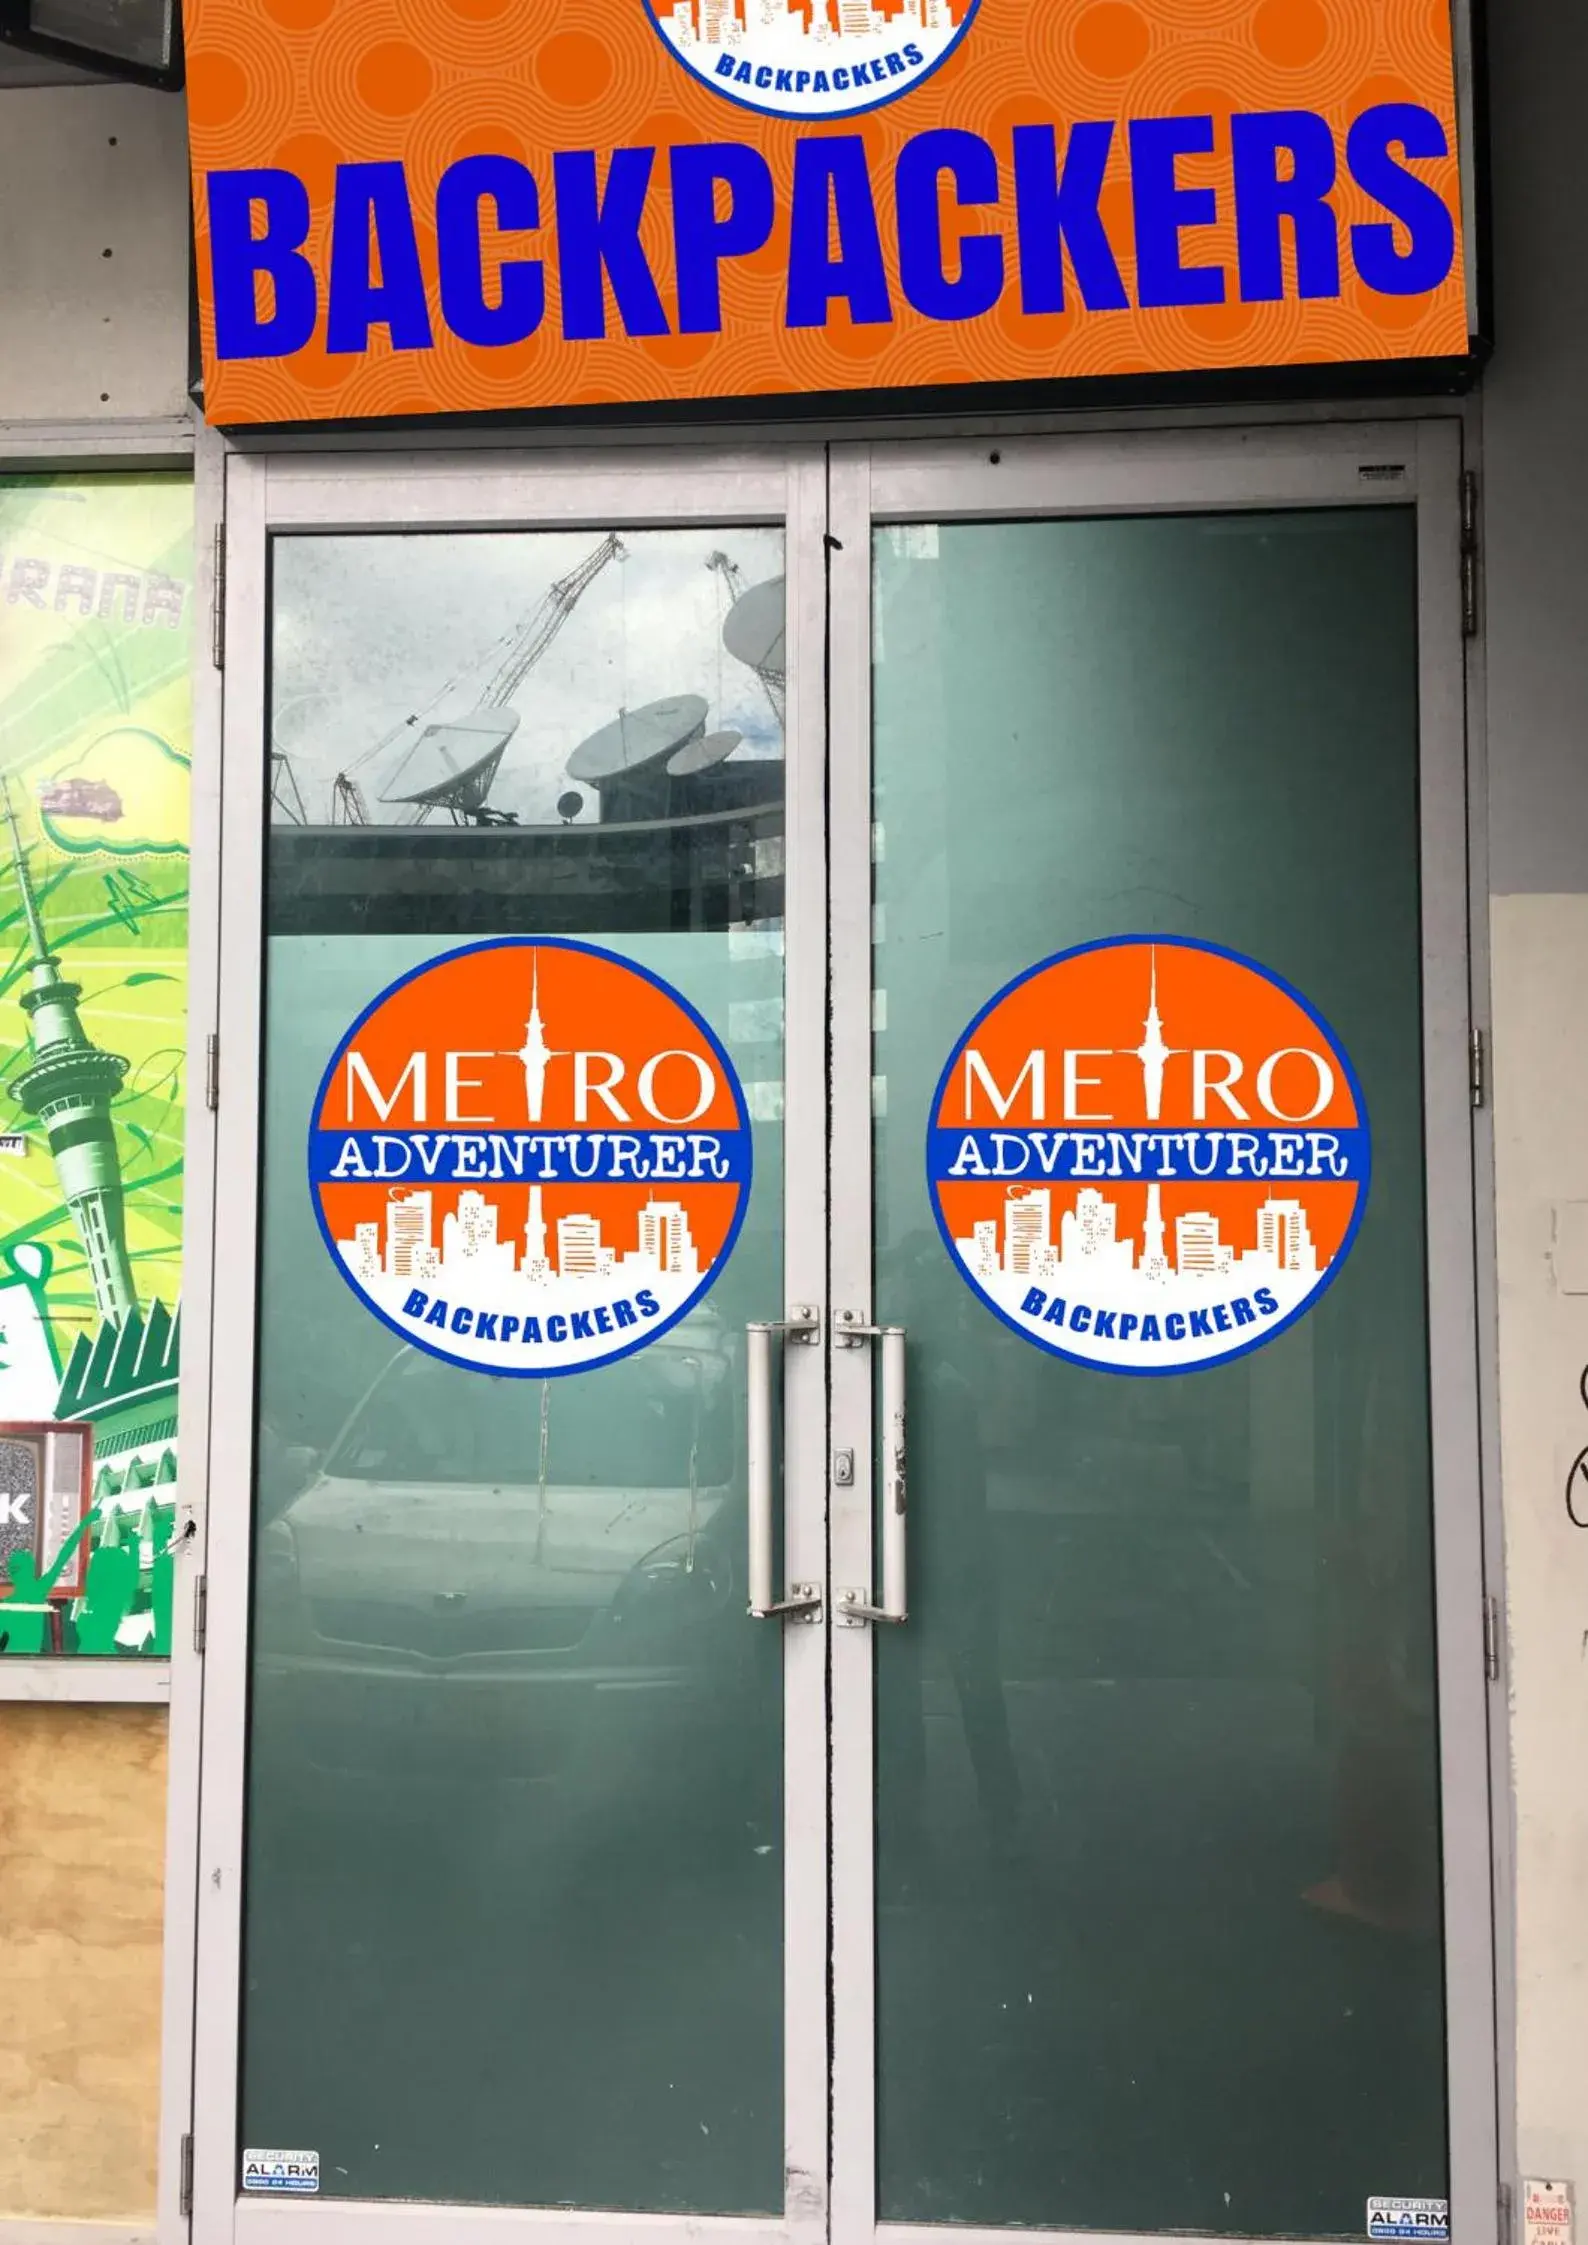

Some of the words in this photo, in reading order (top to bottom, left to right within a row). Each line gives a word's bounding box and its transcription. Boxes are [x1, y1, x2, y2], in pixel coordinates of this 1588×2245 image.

[715, 43, 924, 93] BACKPACKERS
[206, 102, 1456, 361] BACKPACKERS
[0, 557, 187, 629] RANA
[346, 1050, 716, 1124] METRO
[965, 1047, 1335, 1122] METRO
[329, 1134, 730, 1179] ADVENTURER
[948, 1132, 1349, 1177] ADVENTURER
[402, 1288, 661, 1343] BACKPACKERS
[1020, 1286, 1280, 1341] BACKPACKERS
[246, 2163, 318, 2176] ALARM
[1371, 2211, 1448, 2226] ALARM
[1372, 2199, 1445, 2211] SECURITY
[1526, 2206, 1570, 2221] DANGER
